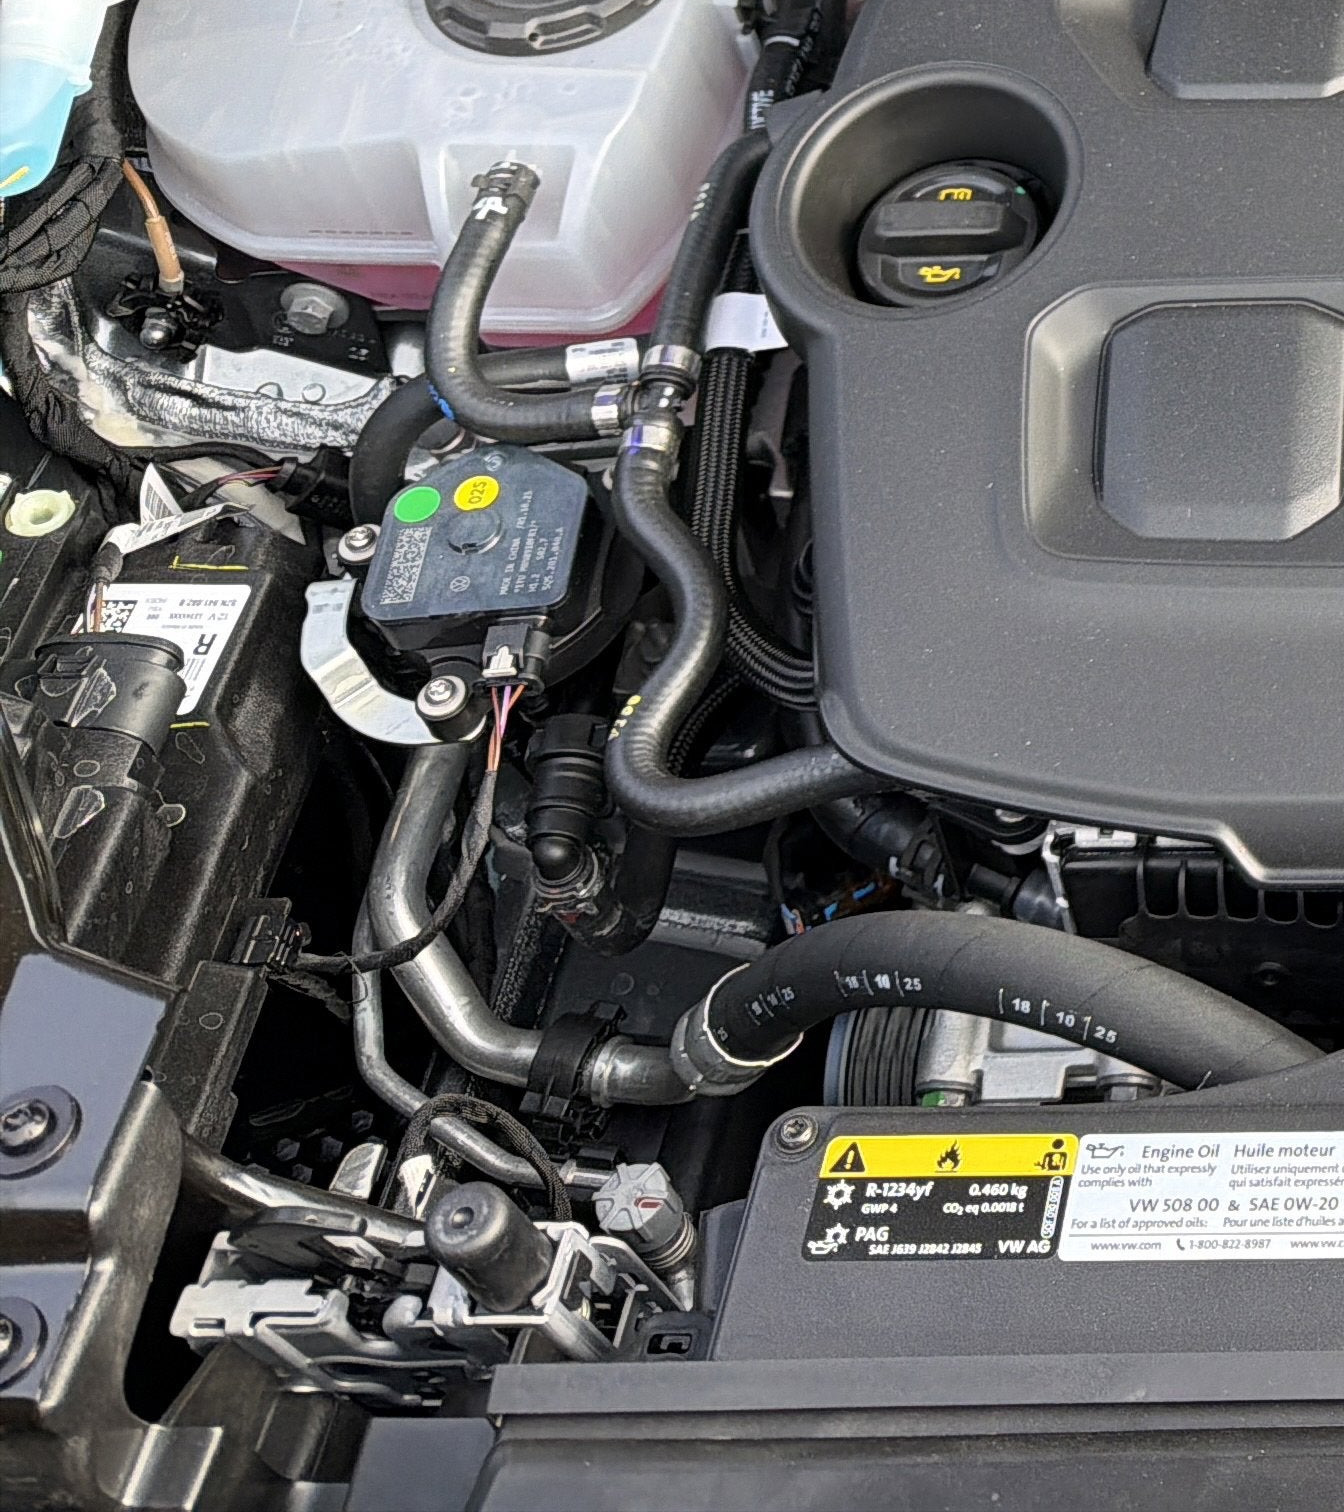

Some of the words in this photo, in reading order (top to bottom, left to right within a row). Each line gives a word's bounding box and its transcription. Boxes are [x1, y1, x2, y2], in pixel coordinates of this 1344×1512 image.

[192, 633, 218, 656] R
[903, 976, 923, 992] 25
[1011, 996, 1032, 1015] 18
[1093, 1024, 1119, 1044] 25
[1142, 1144, 1195, 1162] Engine
[1197, 1143, 1220, 1159] Oil
[1233, 1142, 1275, 1158] Huile
[1278, 1144, 1336, 1158] moteur
[1080, 1164, 1102, 1175] Use
[1103, 1163, 1126, 1177] only
[1127, 1163, 1142, 1174] oil
[1143, 1163, 1165, 1174] that
[1167, 1164, 1218, 1177] expressly
[1230, 1163, 1272, 1175] Utilisez
[1272, 1162, 1340, 1177] uniquement
[865, 1180, 935, 1200] R-1234yf
[968, 1182, 1008, 1197] 0.460
[1010, 1183, 1029, 1200] kg
[1077, 1177, 1126, 1190] complies
[1127, 1177, 1153, 1188] with
[1228, 1176, 1247, 1190] qui
[1248, 1176, 1291, 1188] satisfait
[1128, 1198, 1160, 1213] VW
[1162, 1197, 1193, 1213] 508
[1197, 1197, 1220, 1212] 00
[1227, 1198, 1241, 1212] &
[1248, 1197, 1281, 1212] SAE
[1283, 1196, 1340, 1211] 0W-20
[1070, 1217, 1088, 1230] For
[1099, 1217, 1116, 1229] list
[1117, 1216, 1132, 1229] of
[1132, 1216, 1184, 1231] approved
[1222, 1216, 1248, 1228] Pour
[1250, 1216, 1270, 1228] une
[1271, 1215, 1294, 1227] liste
[854, 1226, 891, 1242] PAG
[997, 1239, 1024, 1254] VW
[1025, 1239, 1052, 1255] AG
[1090, 1240, 1162, 1251] www.vw.com
[1189, 1238, 1272, 1251] 1-800-822-8987
